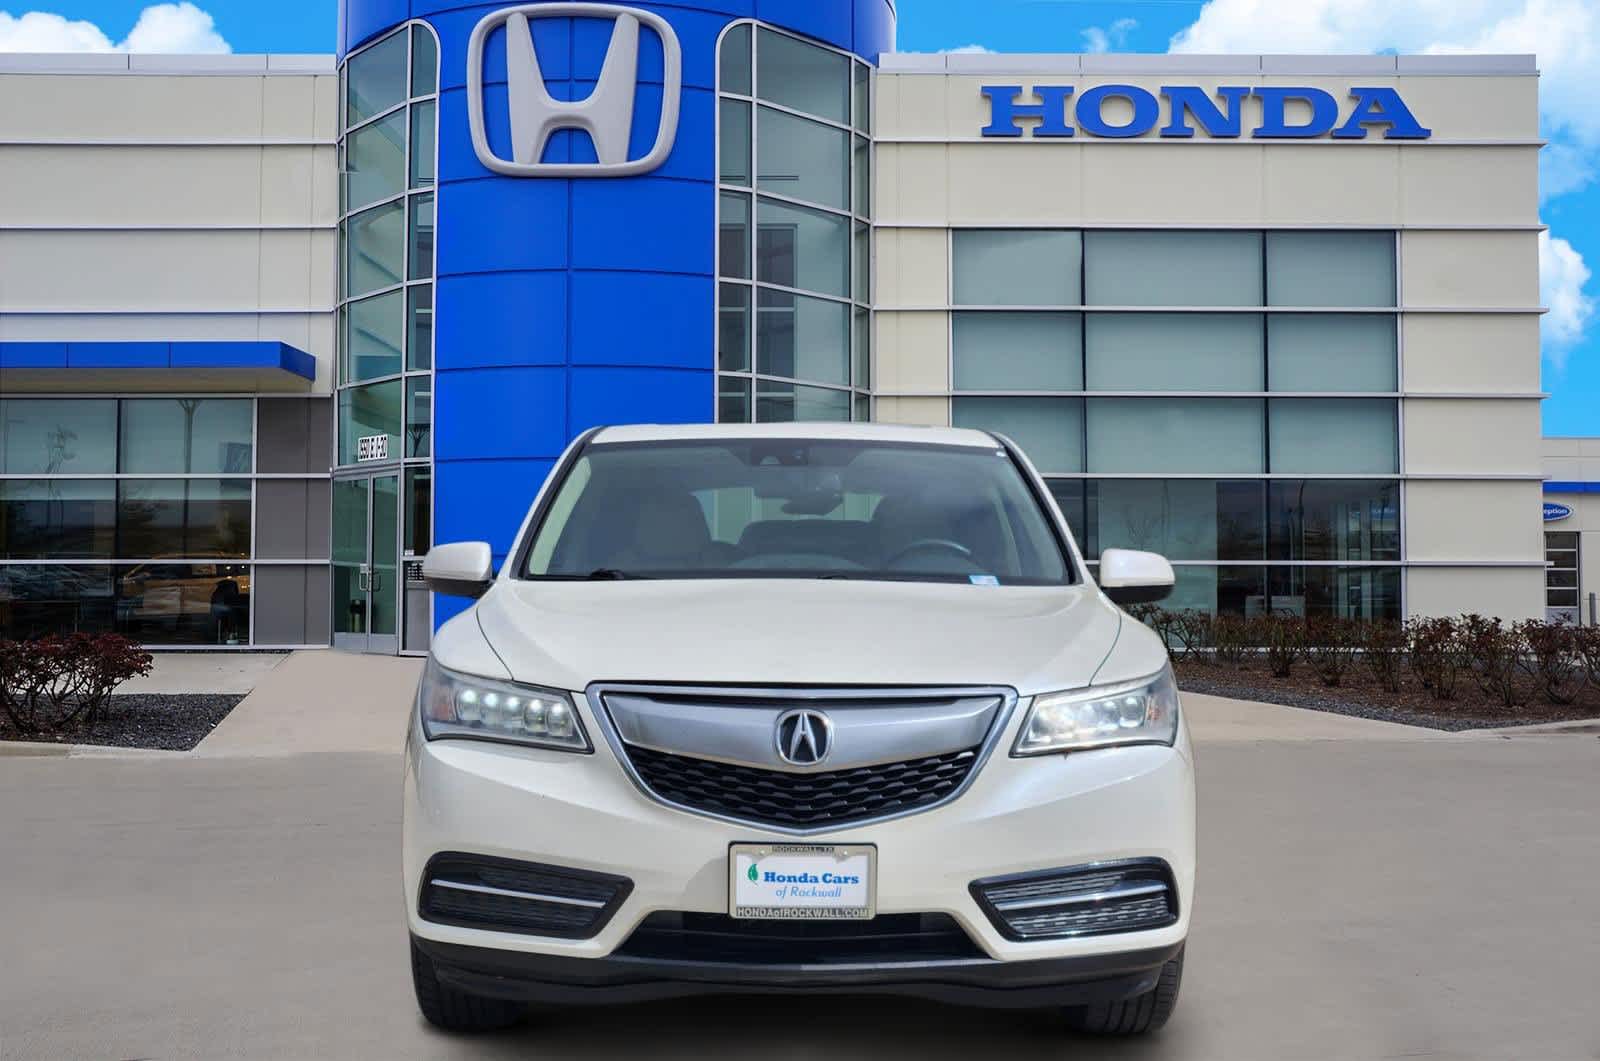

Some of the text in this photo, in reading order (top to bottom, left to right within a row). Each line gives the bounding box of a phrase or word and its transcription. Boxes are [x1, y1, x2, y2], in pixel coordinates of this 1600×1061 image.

[981, 84, 1432, 139] HONDA
[763, 872, 859, 884] Honda Cars
[775, 886, 842, 898] of Rockwall
